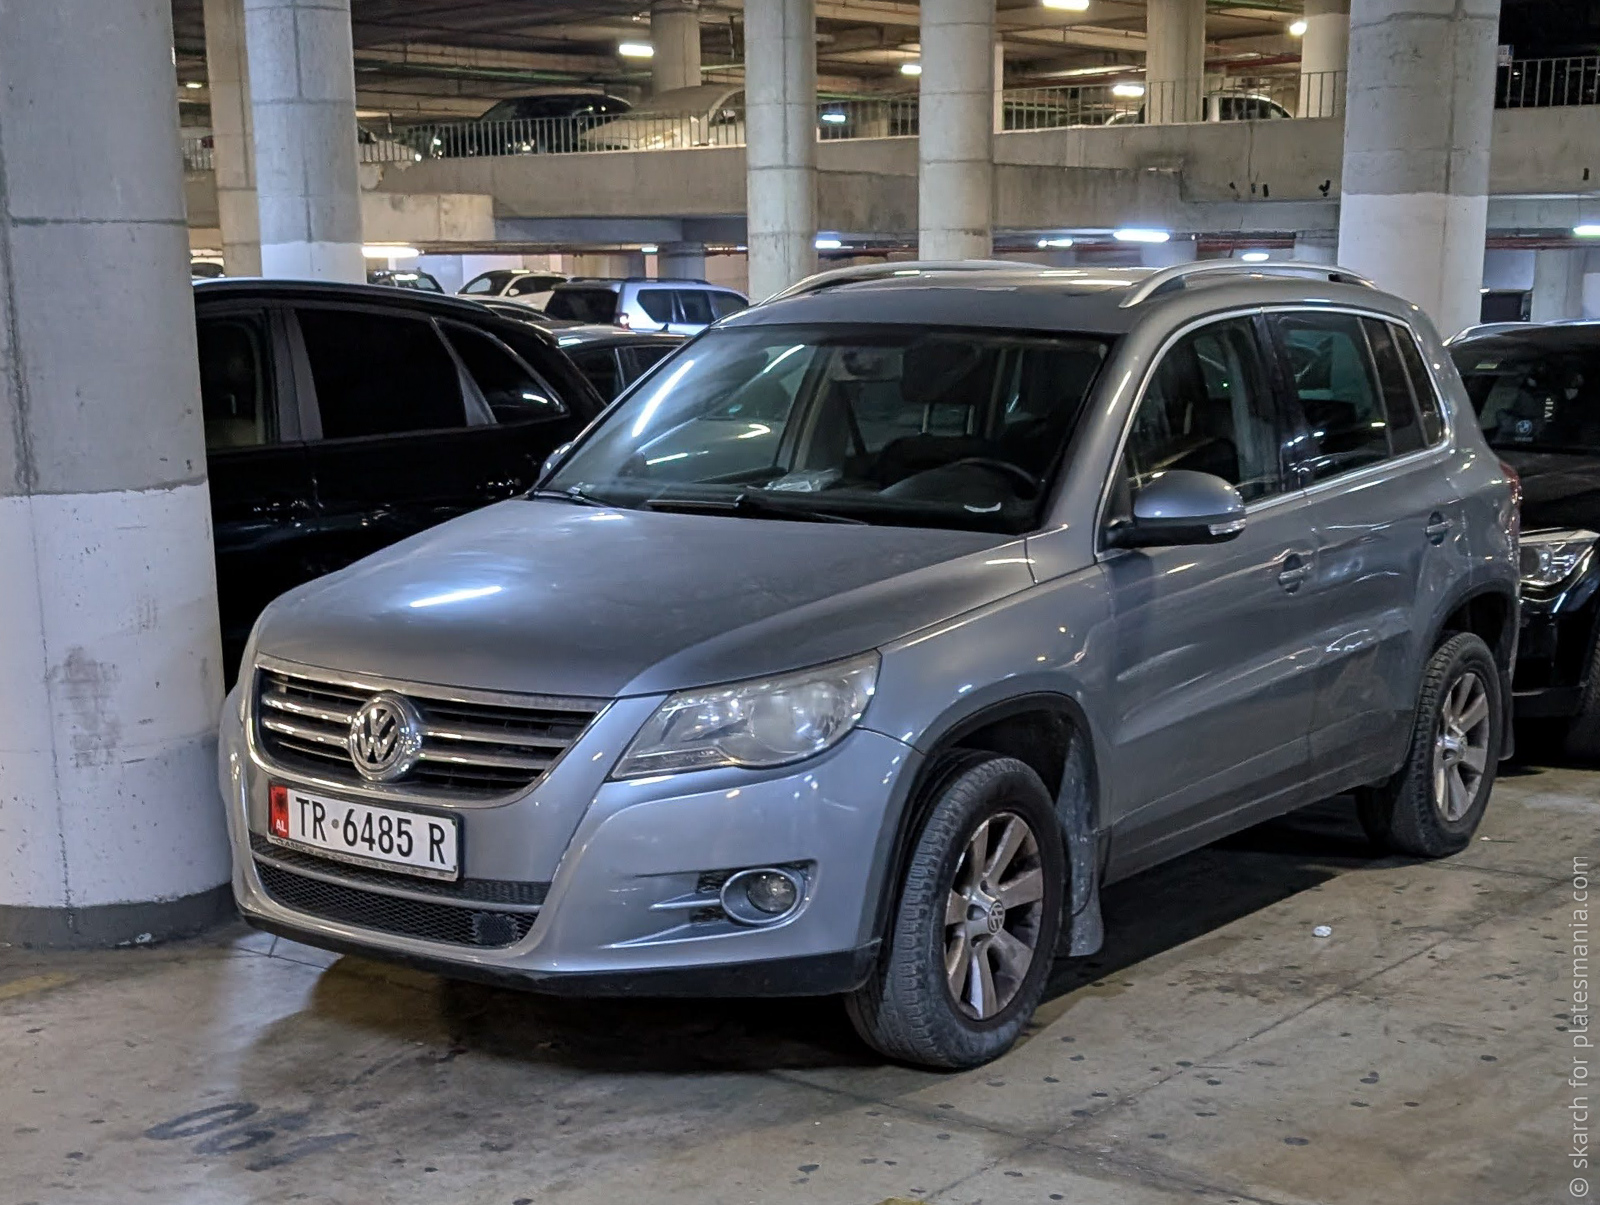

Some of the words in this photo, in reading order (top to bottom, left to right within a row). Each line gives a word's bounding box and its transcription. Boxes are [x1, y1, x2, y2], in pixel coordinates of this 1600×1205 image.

[275, 819, 287, 833] AL
[296, 797, 327, 842] TR
[343, 809, 413, 858] 6485
[428, 823, 446, 865] R
